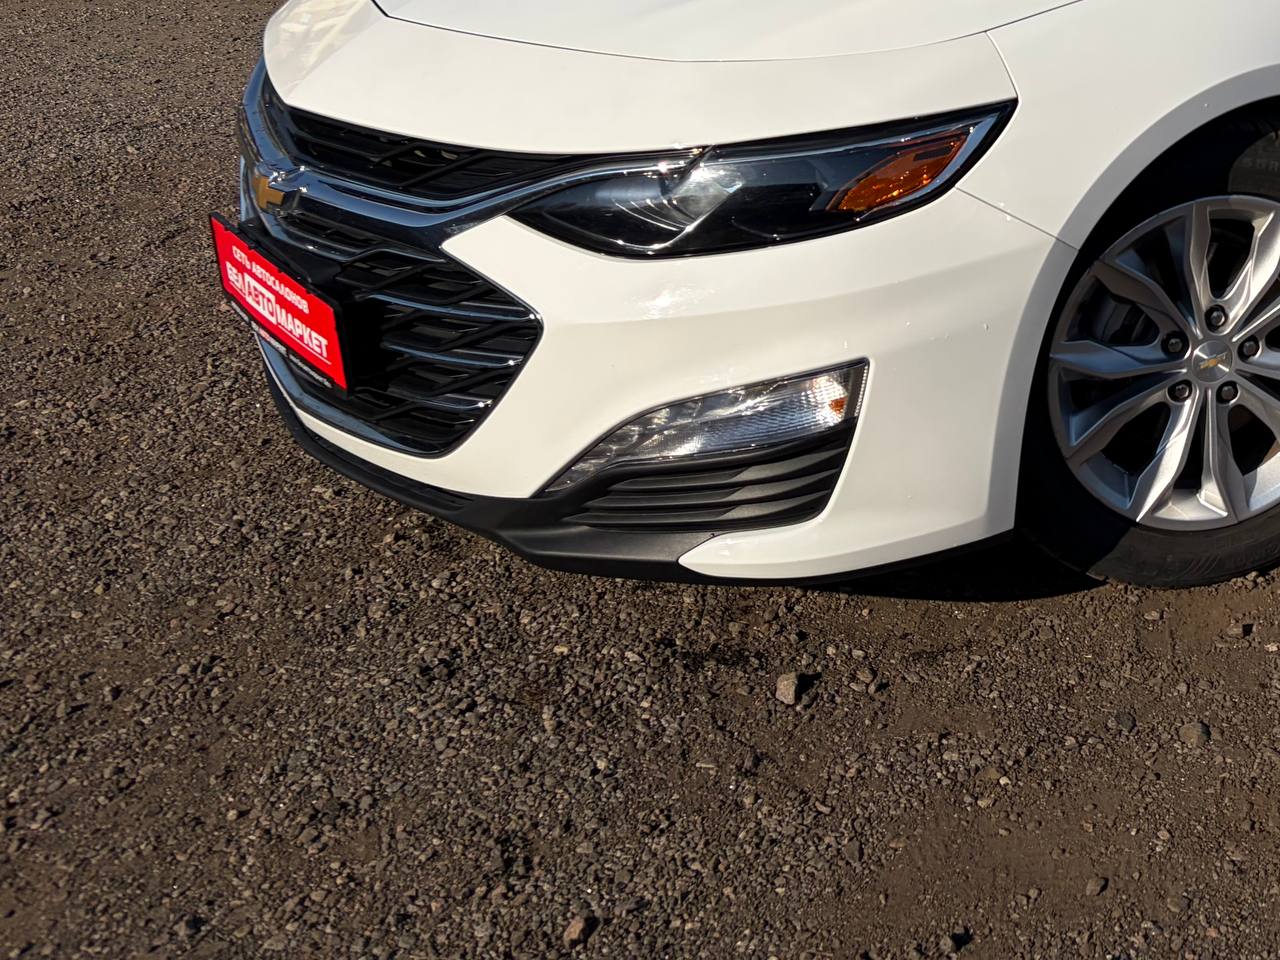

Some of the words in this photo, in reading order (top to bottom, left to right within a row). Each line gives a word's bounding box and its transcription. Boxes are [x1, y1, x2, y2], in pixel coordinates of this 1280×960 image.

[231, 245, 252, 271] СЕТЬ
[251, 261, 310, 315] АВТОСАЛОНОВ
[246, 277, 275, 317] АВТО
[275, 303, 329, 359] МАРКЕТ
